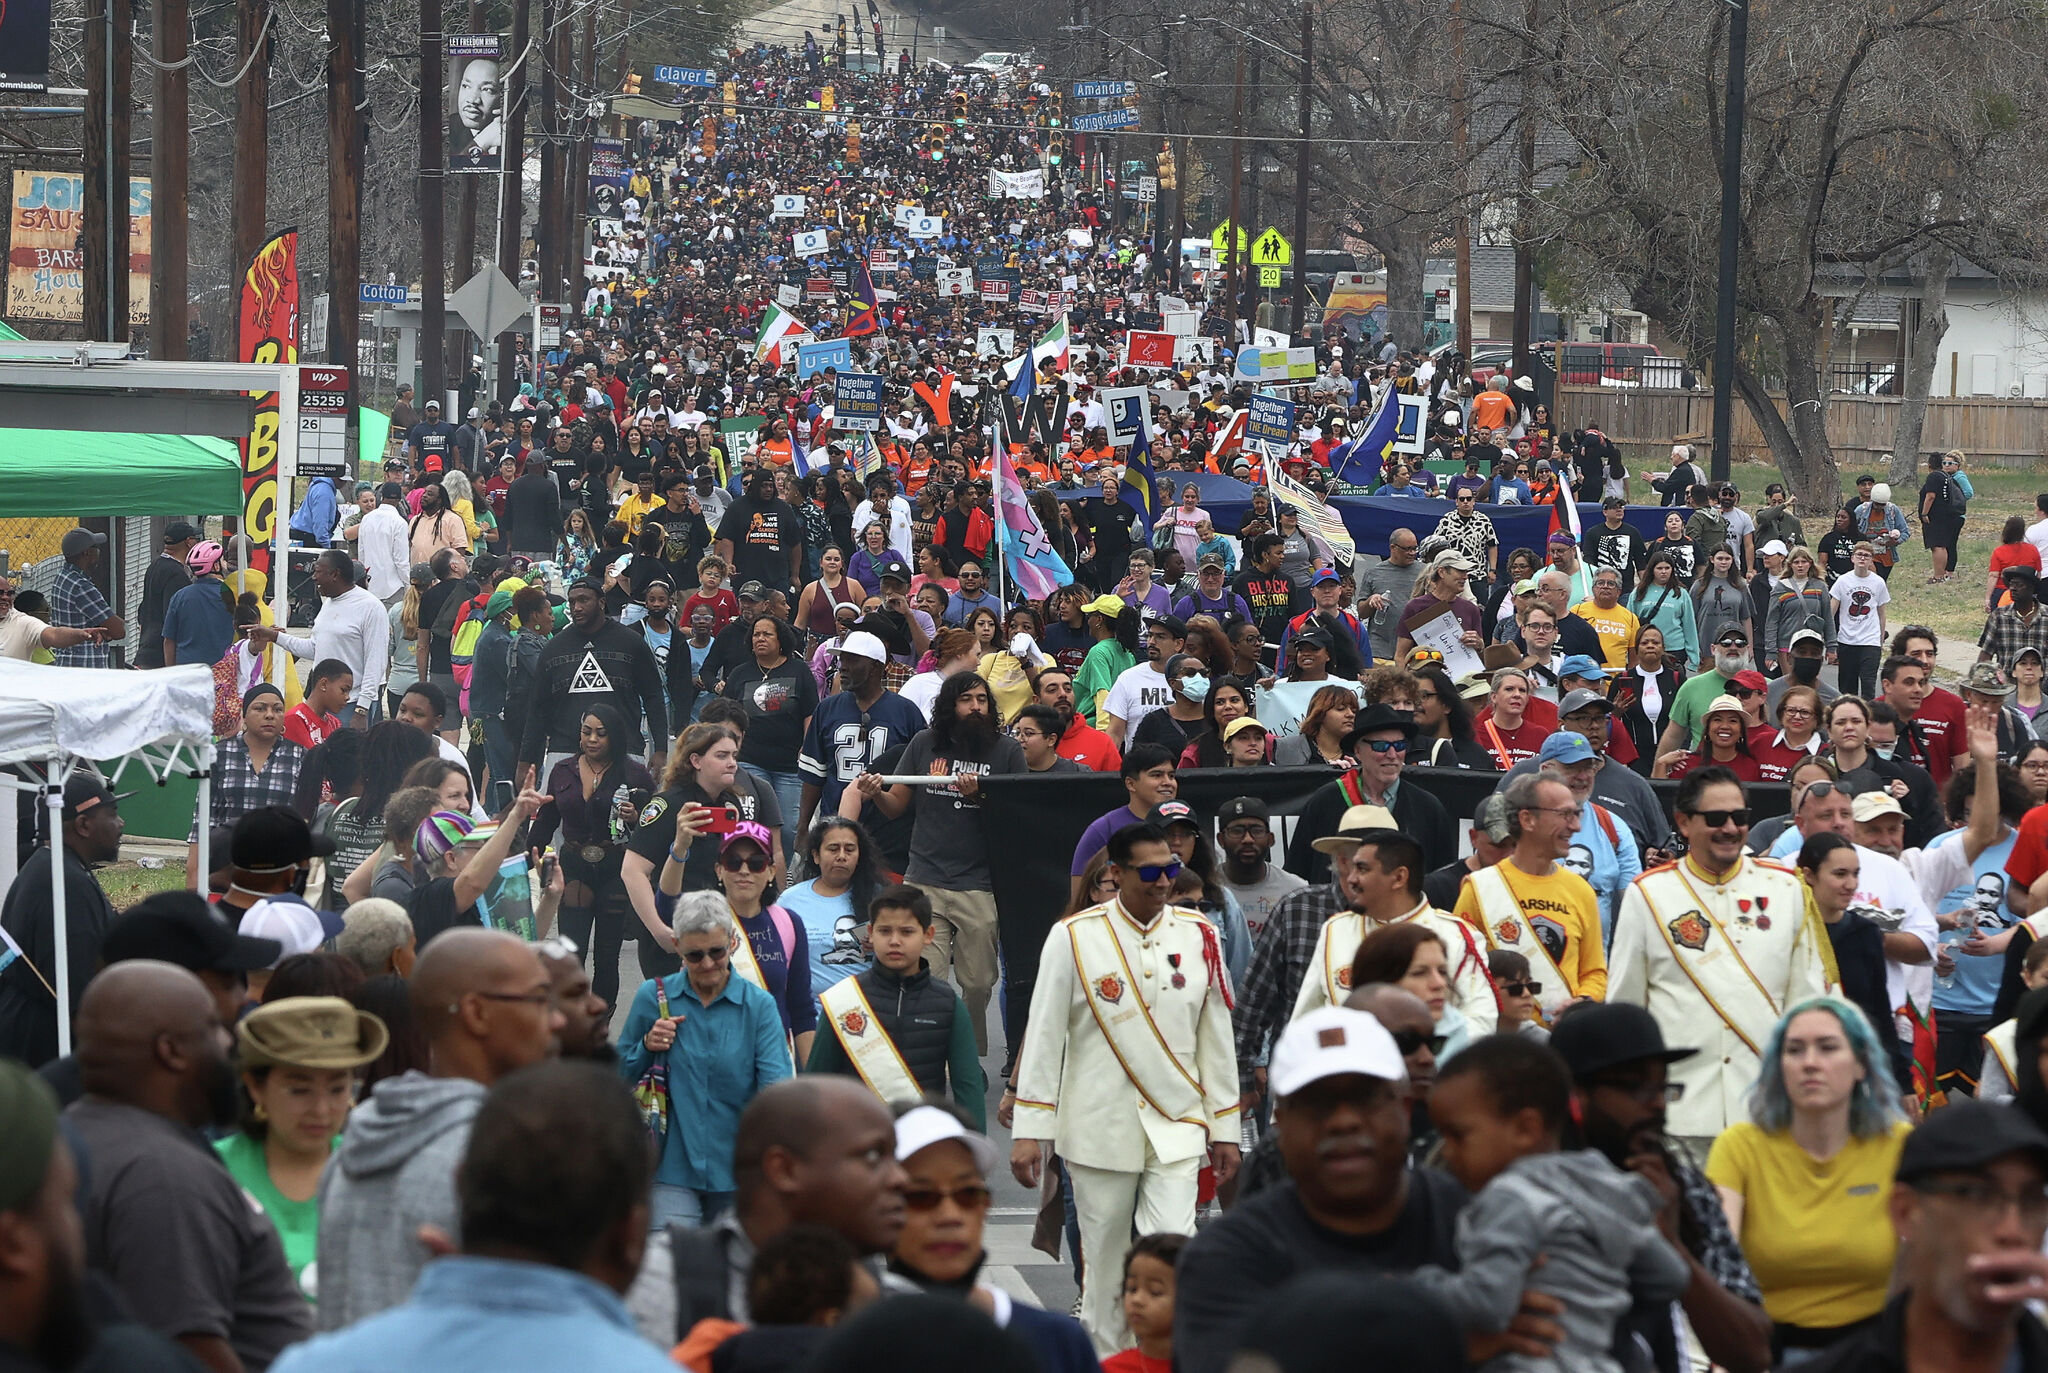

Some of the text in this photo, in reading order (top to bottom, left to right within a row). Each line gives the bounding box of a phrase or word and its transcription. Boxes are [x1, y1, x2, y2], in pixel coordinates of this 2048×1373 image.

[659, 67, 702, 83] Claver
[0, 82, 44, 90] ommission
[1077, 83, 1123, 97] Amanda
[1140, 190, 1156, 200] 35
[1263, 270, 1277, 280] 20
[363, 284, 405, 301] Cotton
[10, 305, 35, 320] 2827
[805, 356, 816, 369] U
[833, 352, 844, 365] U
[313, 373, 330, 382] VIA
[838, 377, 874, 389] Together
[303, 395, 345, 407] 25259
[838, 388, 877, 400] We Can Be
[852, 400, 878, 411] Dream
[1252, 398, 1286, 414] Together
[302, 419, 318, 430] 26
[1250, 409, 1288, 427] We Can Be
[1262, 424, 1289, 438] Dream
[1247, 579, 1289, 595] BLACK
[1251, 594, 1289, 608] HISTORY
[1595, 624, 1627, 638] LOVE
[586, 662, 593, 671] 2
[1141, 687, 1176, 706] ML
[834, 723, 889, 780] 21
[1513, 748, 1536, 757] Memory
[952, 759, 991, 777] PUBLIC
[934, 789, 958, 798] Leadership
[724, 821, 772, 844] LOVE
[1519, 898, 1571, 915] ARSHAL
[747, 925, 774, 942] on't
